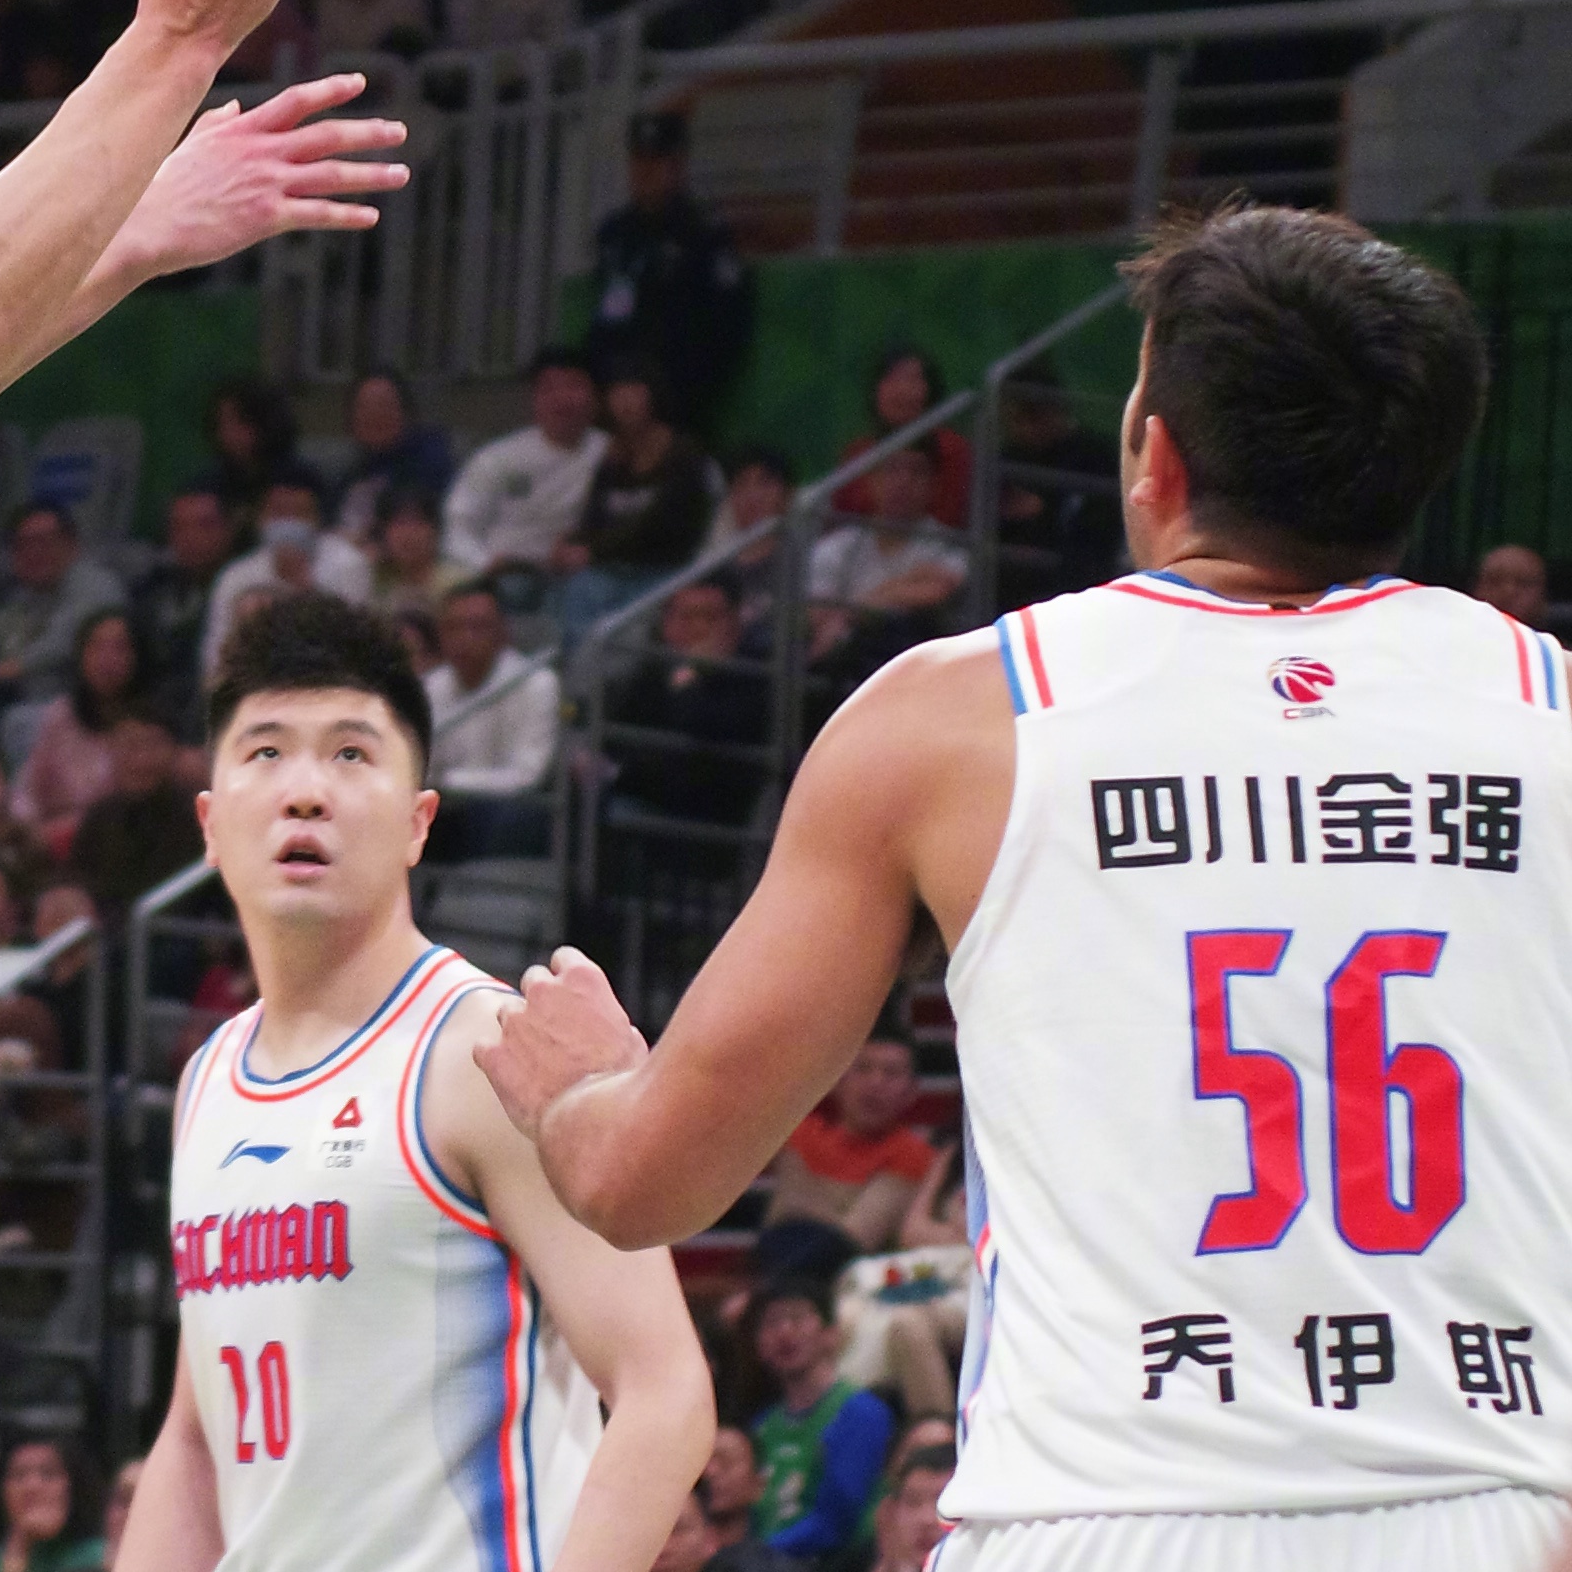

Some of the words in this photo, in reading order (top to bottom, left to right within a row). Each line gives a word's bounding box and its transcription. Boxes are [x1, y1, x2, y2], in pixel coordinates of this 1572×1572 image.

[1090, 773, 1523, 873] 四川金强
[1186, 928, 1466, 1257] 56
[220, 1340, 290, 1463] 20
[1141, 1313, 1543, 1415] 乔伊斯
